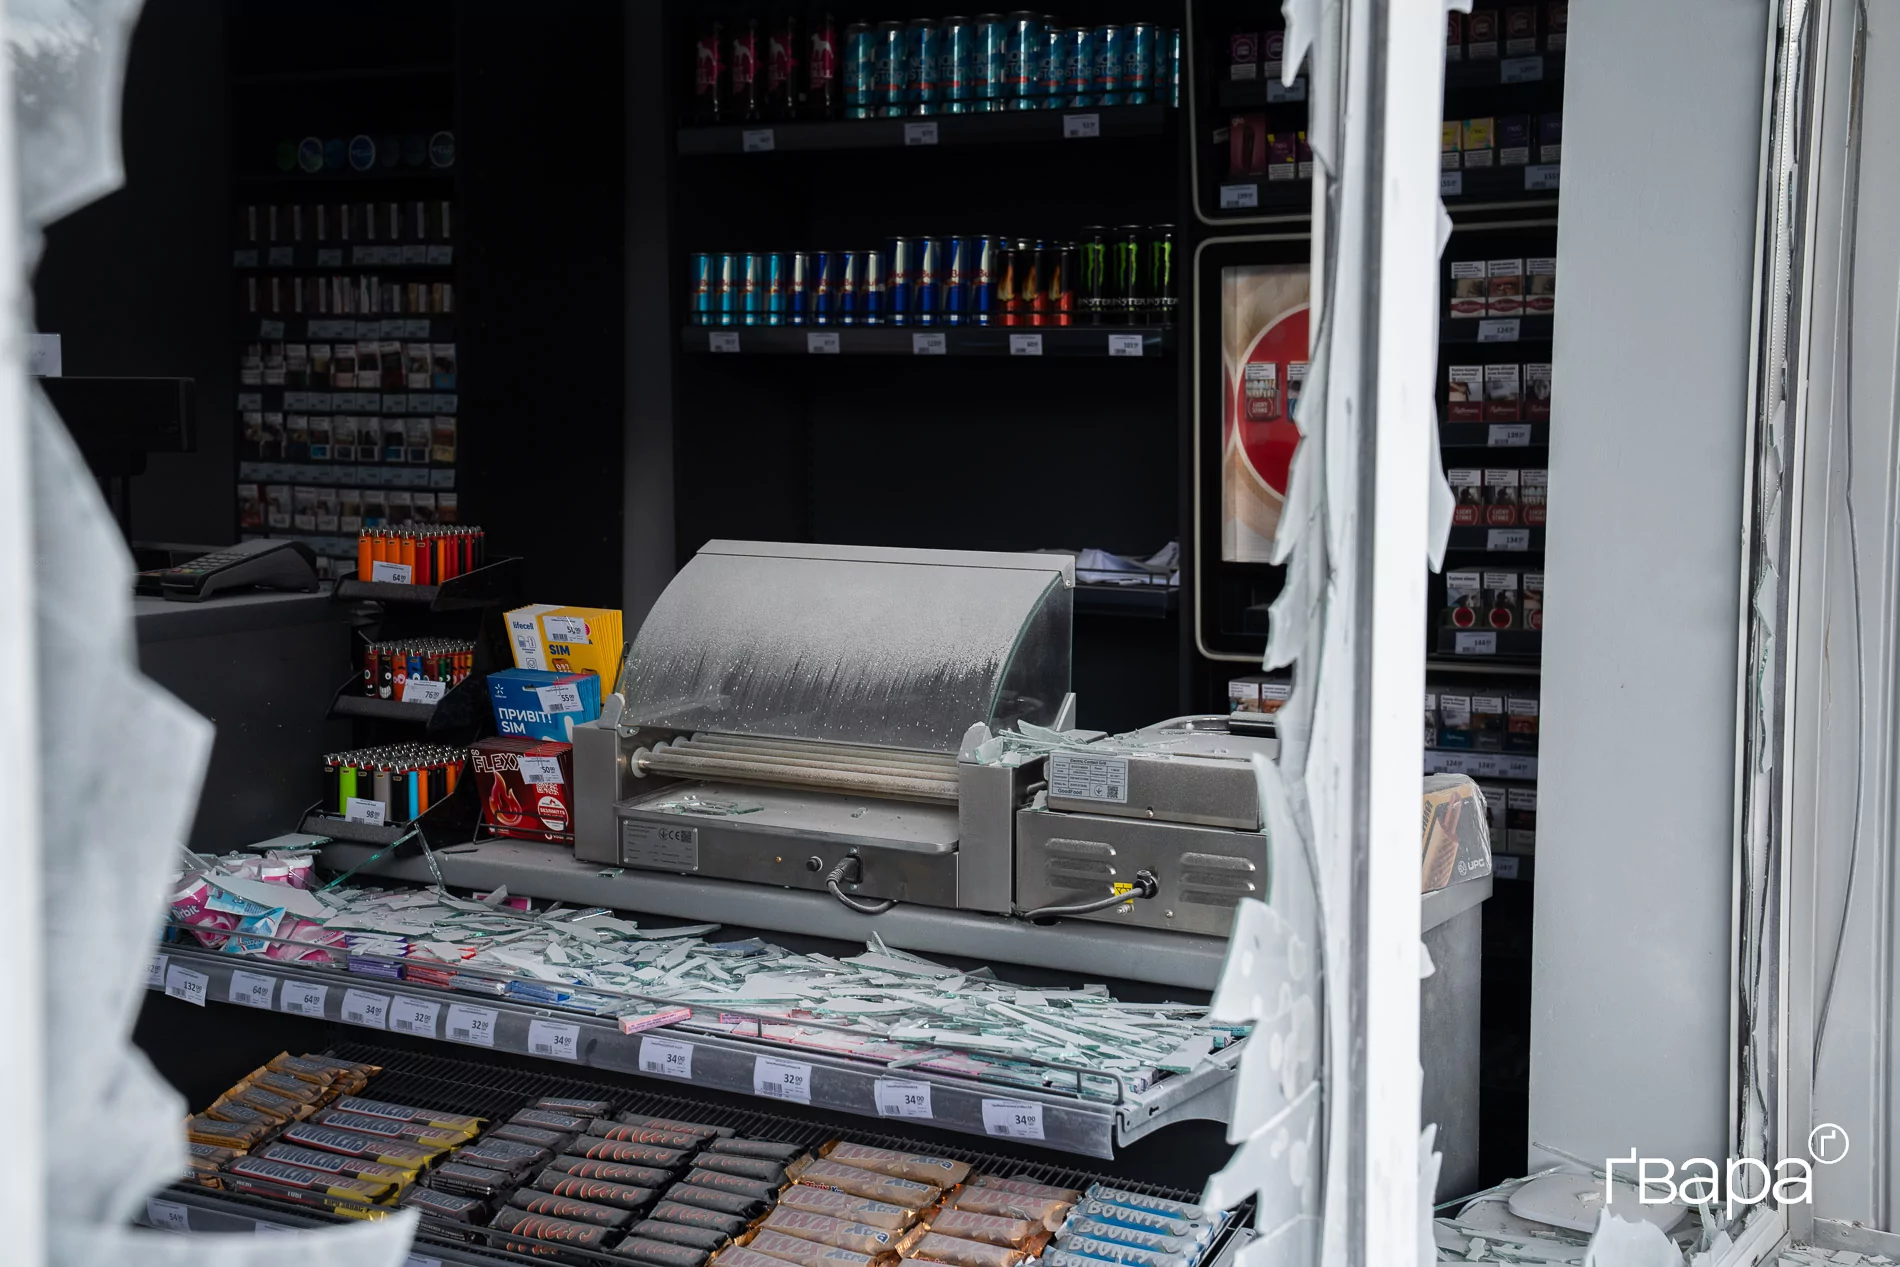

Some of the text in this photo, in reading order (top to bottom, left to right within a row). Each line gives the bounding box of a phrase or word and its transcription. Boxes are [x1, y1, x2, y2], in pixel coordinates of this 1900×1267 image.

[512, 621, 535, 630] lifecell
[548, 644, 571, 656] SIM
[498, 708, 553, 724] ПРИВІТ!
[502, 720, 527, 734] SIM
[173, 904, 200, 922] Orbit
[554, 1177, 639, 1199] Mars
[1101, 1186, 1181, 1213] BOUNTY
[1087, 1200, 1169, 1228] BOUNTY
[512, 1215, 598, 1240] Mars
[1078, 1219, 1161, 1246] BOUNTY
[1068, 1235, 1153, 1264] BOUNTY
